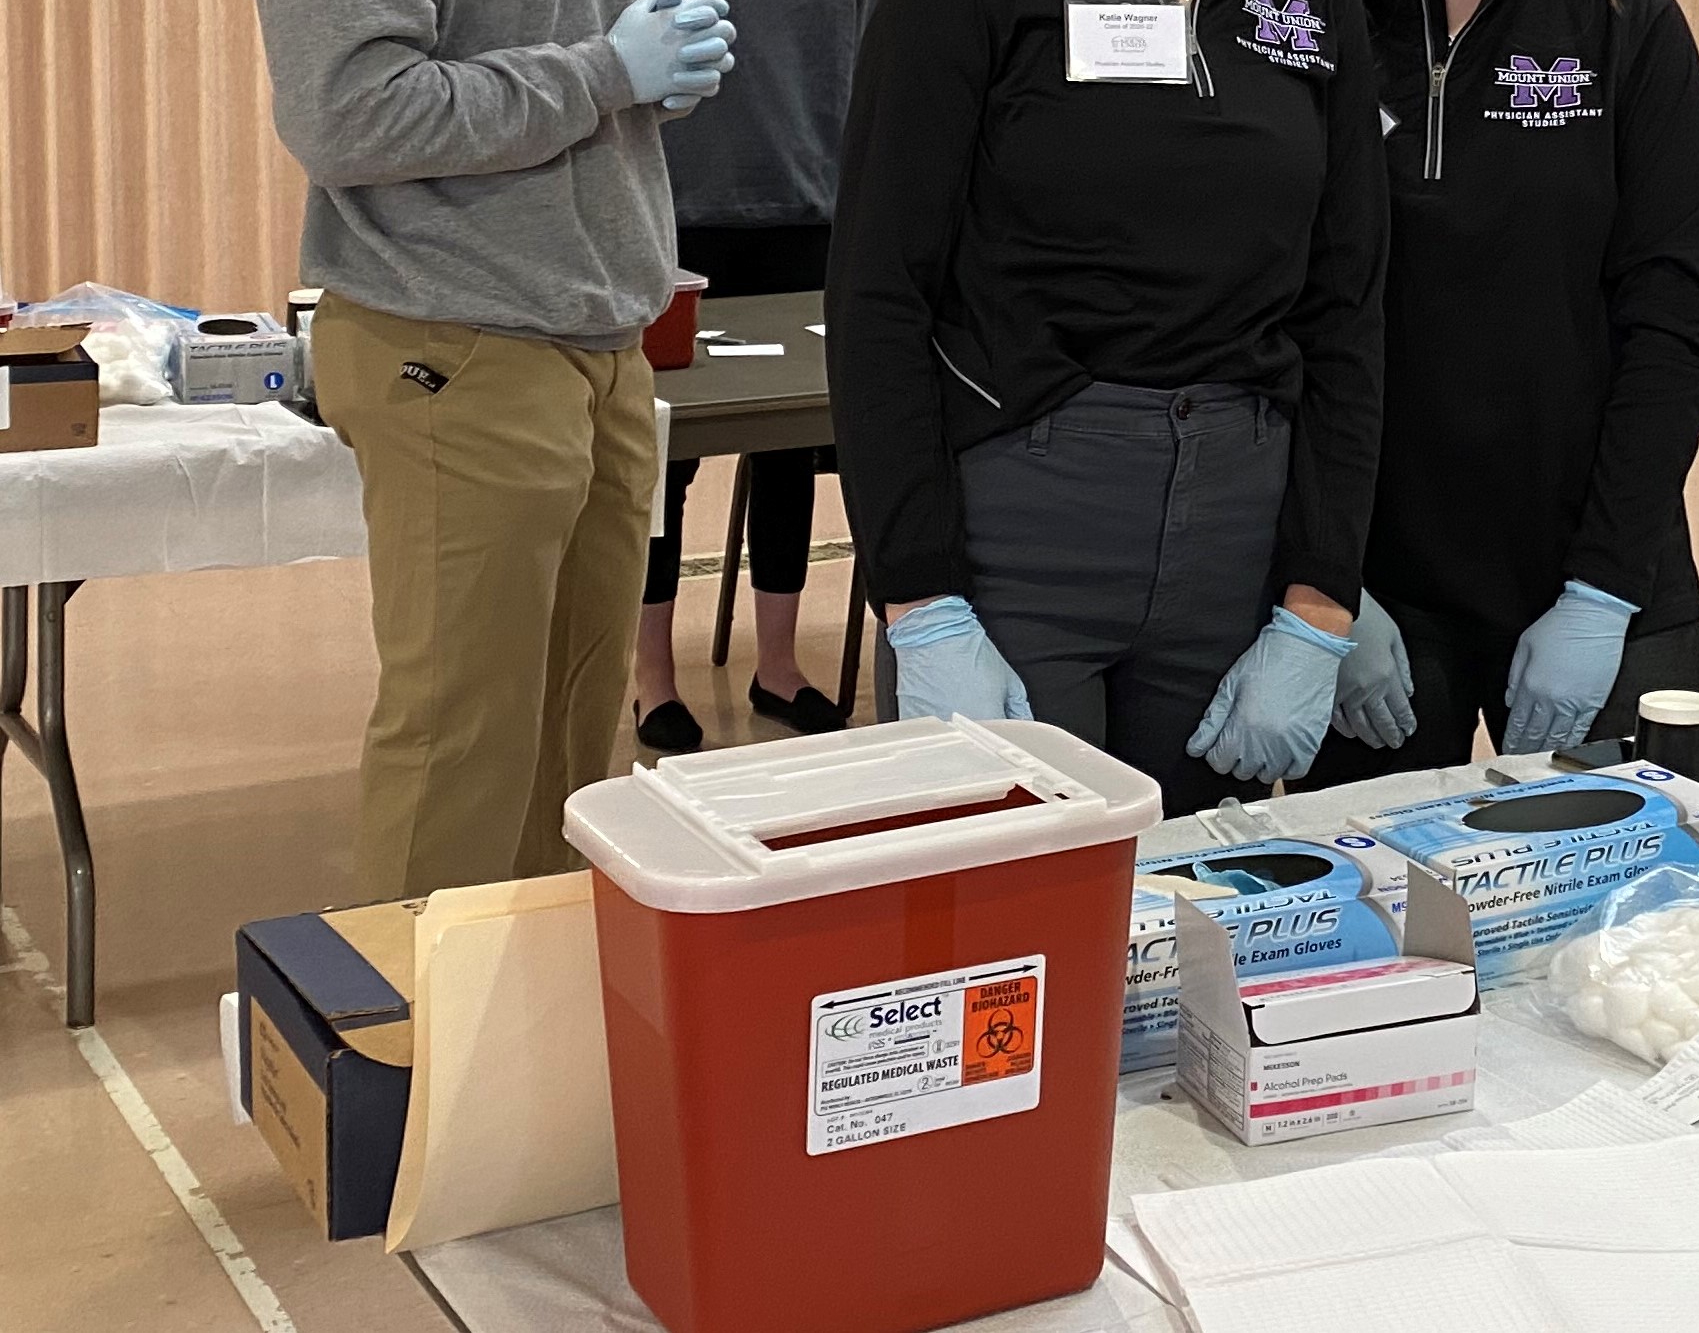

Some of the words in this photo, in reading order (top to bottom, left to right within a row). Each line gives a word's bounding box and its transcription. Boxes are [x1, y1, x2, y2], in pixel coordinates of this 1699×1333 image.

[1099, 13, 1121, 22] Katie
[1124, 13, 1158, 23] Wagner
[1282, 13, 1322, 30] UNION
[1236, 35, 1285, 59] PHYSICIAN
[1287, 52, 1336, 72] ASSISTANT
[1268, 55, 1309, 70] STUDIES
[1497, 71, 1546, 84] MOUNT
[1547, 73, 1590, 84] UNION
[1483, 110, 1541, 121] PHYSICIAN
[1544, 108, 1604, 120] ASSISTANT
[1521, 118, 1567, 128] STUDIES
[268, 374, 278, 389] L
[1544, 821, 1659, 850] TACTILE
[1451, 843, 1534, 867] PLUS
[1456, 852, 1577, 897] TACTILE
[1584, 834, 1665, 868] PLUS
[1468, 890, 1540, 913] owder-Free
[1543, 877, 1585, 897] Nitrile
[1587, 872, 1620, 887] Exam
[1246, 907, 1343, 947] PLUS
[1473, 920, 1509, 939] proved
[1511, 914, 1544, 930] Tactile
[1251, 946, 1291, 965] Exam
[1294, 936, 1343, 957] Gloves
[1126, 965, 1180, 987] wder-Fr
[980, 981, 1022, 1000] DANGER
[869, 996, 942, 1028] Select
[971, 991, 1031, 1014] BIOHAZARD
[1123, 999, 1158, 1015] roved
[821, 1070, 880, 1093] REGULATED
[881, 1061, 925, 1080] MEDICAL
[926, 1054, 960, 1071] WASTE
[1263, 1078, 1300, 1092] Alcohol
[1302, 1076, 1325, 1087] Prep
[1325, 1072, 1348, 1083] Pads
[826, 1124, 847, 1134] Cat.
[851, 1119, 868, 1129] No.
[874, 1112, 893, 1125] 047
[1277, 1120, 1289, 1128] 1.2
[826, 1138, 834, 1147] 2
[836, 1128, 880, 1145] GALLON
[883, 1122, 907, 1135] SIZE
